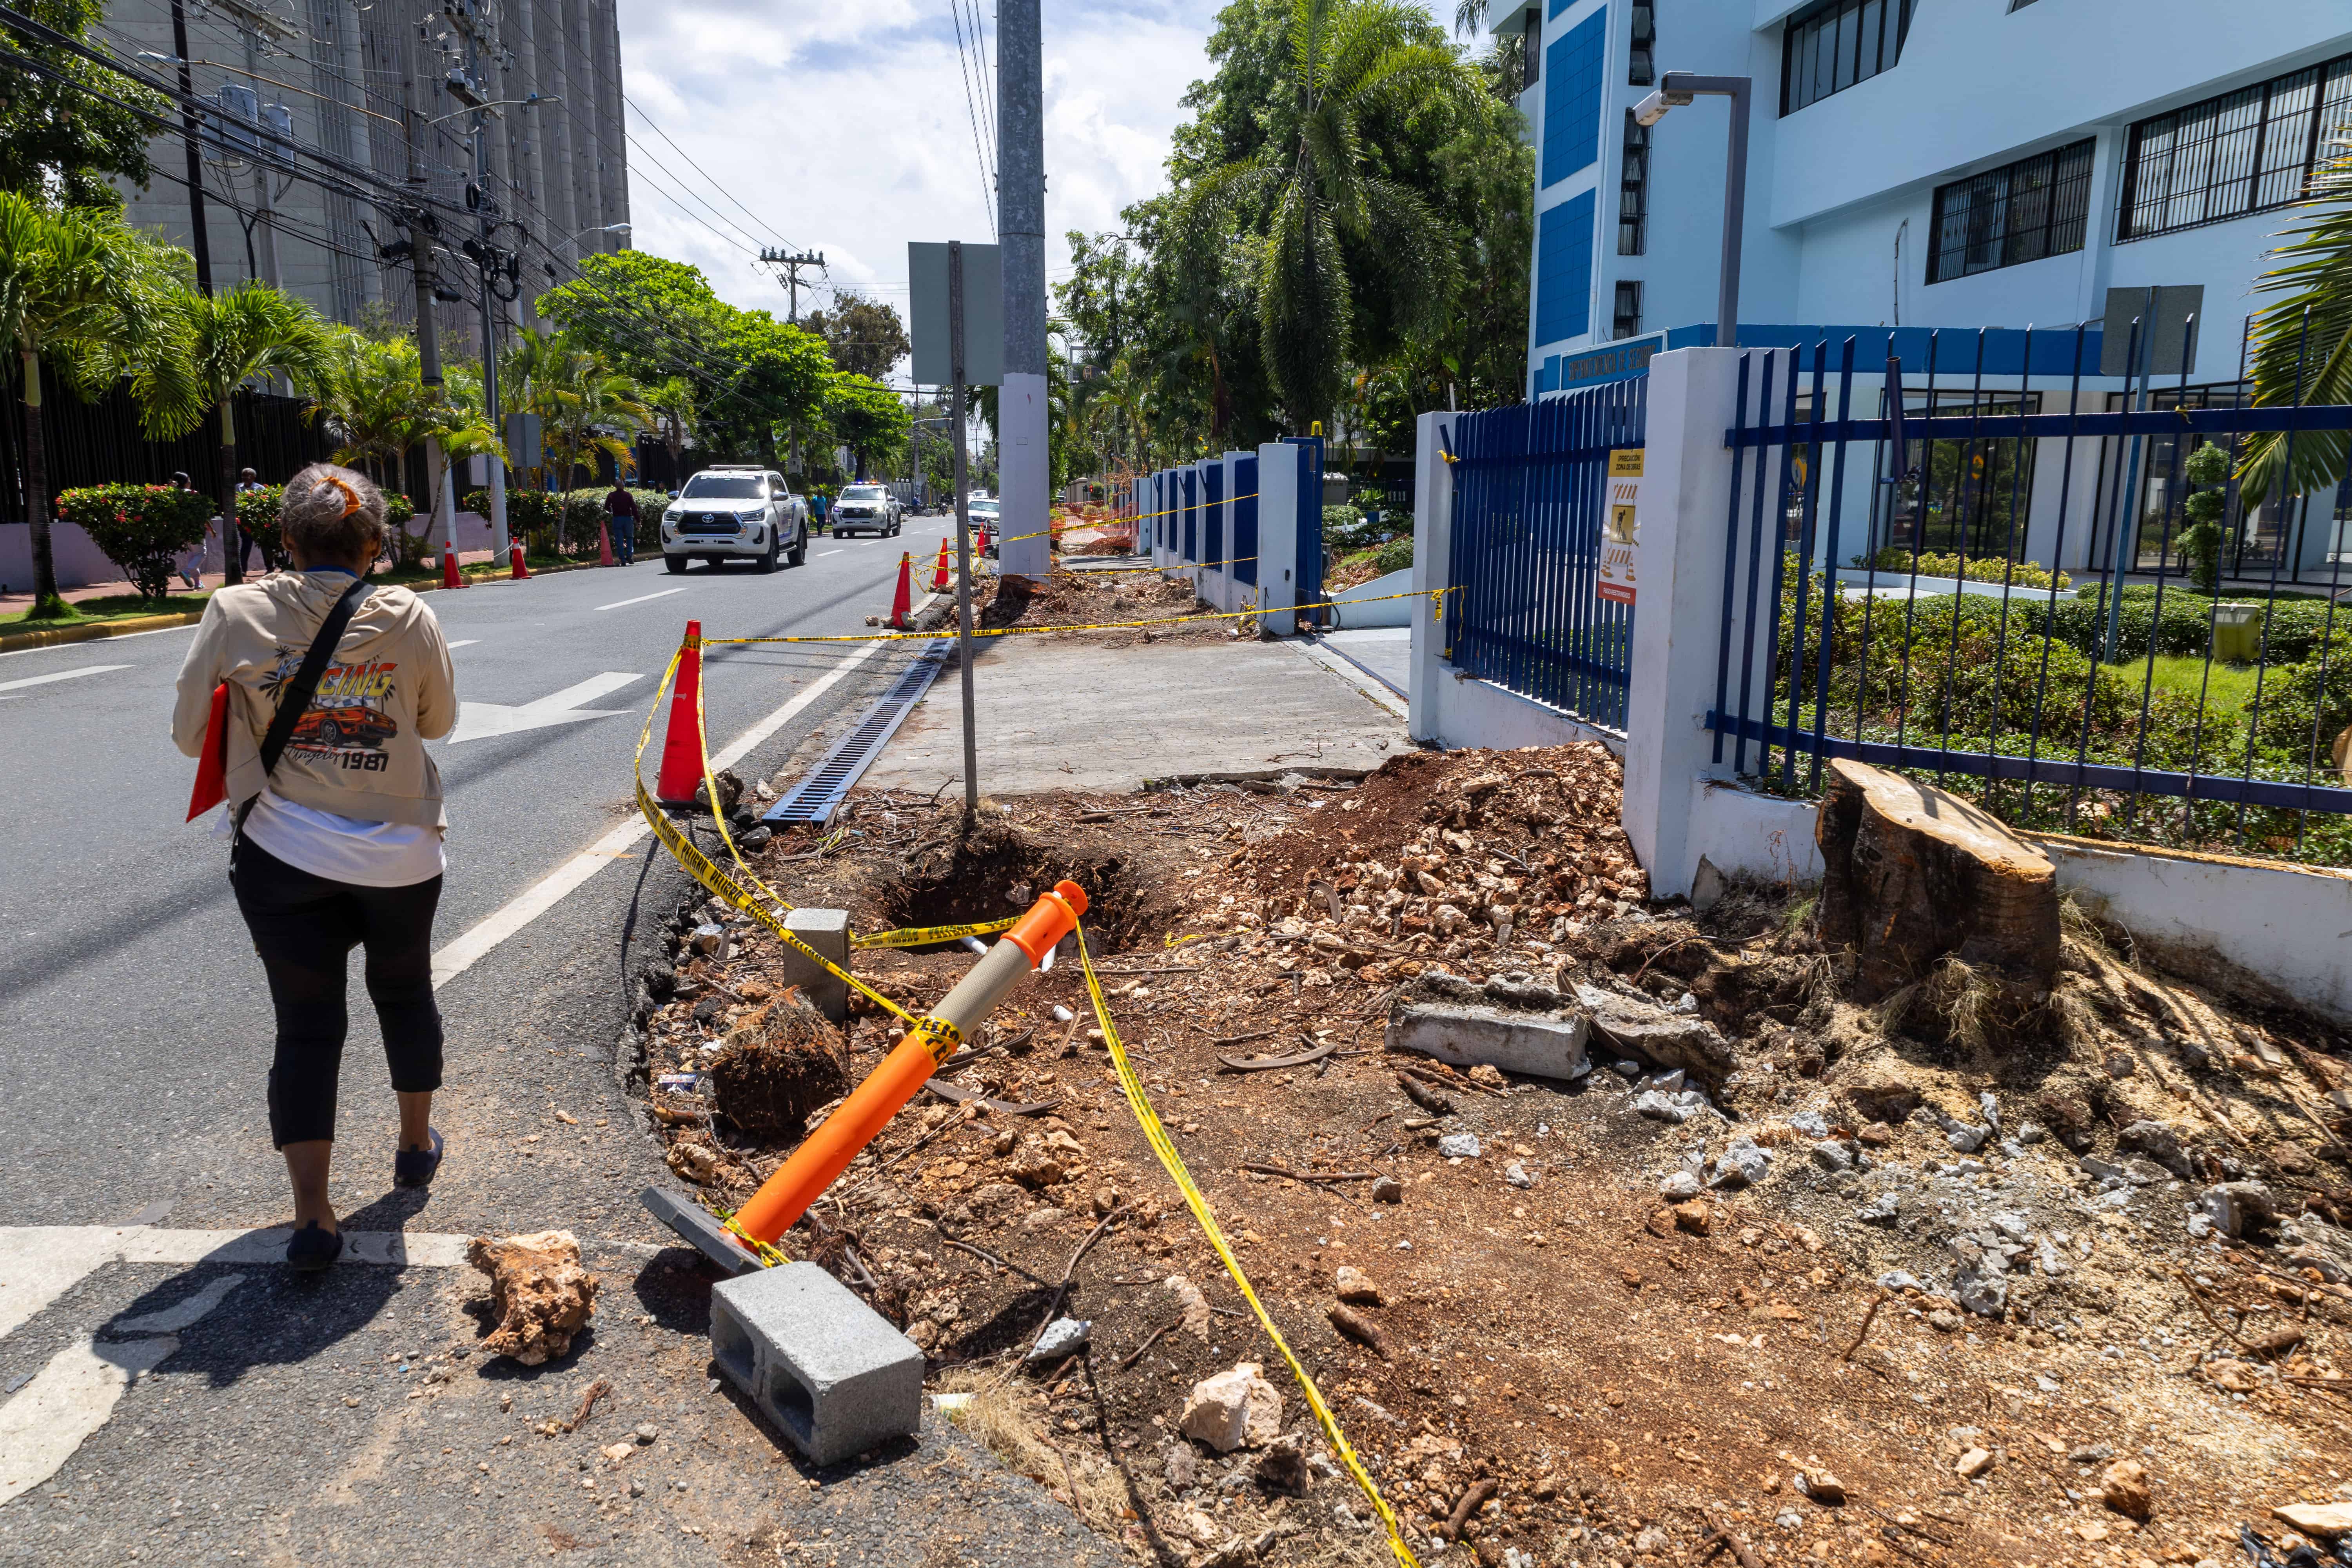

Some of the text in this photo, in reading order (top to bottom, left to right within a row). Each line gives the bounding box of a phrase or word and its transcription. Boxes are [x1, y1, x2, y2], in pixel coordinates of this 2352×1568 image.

[1568, 345, 1656, 381] SUPERINTENDENCIA DE SEGUROS
[1611, 589, 1631, 599] RESTRINGIDO
[342, 751, 389, 772] 1987
[681, 844, 709, 878] PELIGRO
[710, 868, 744, 906] PELIGRO
